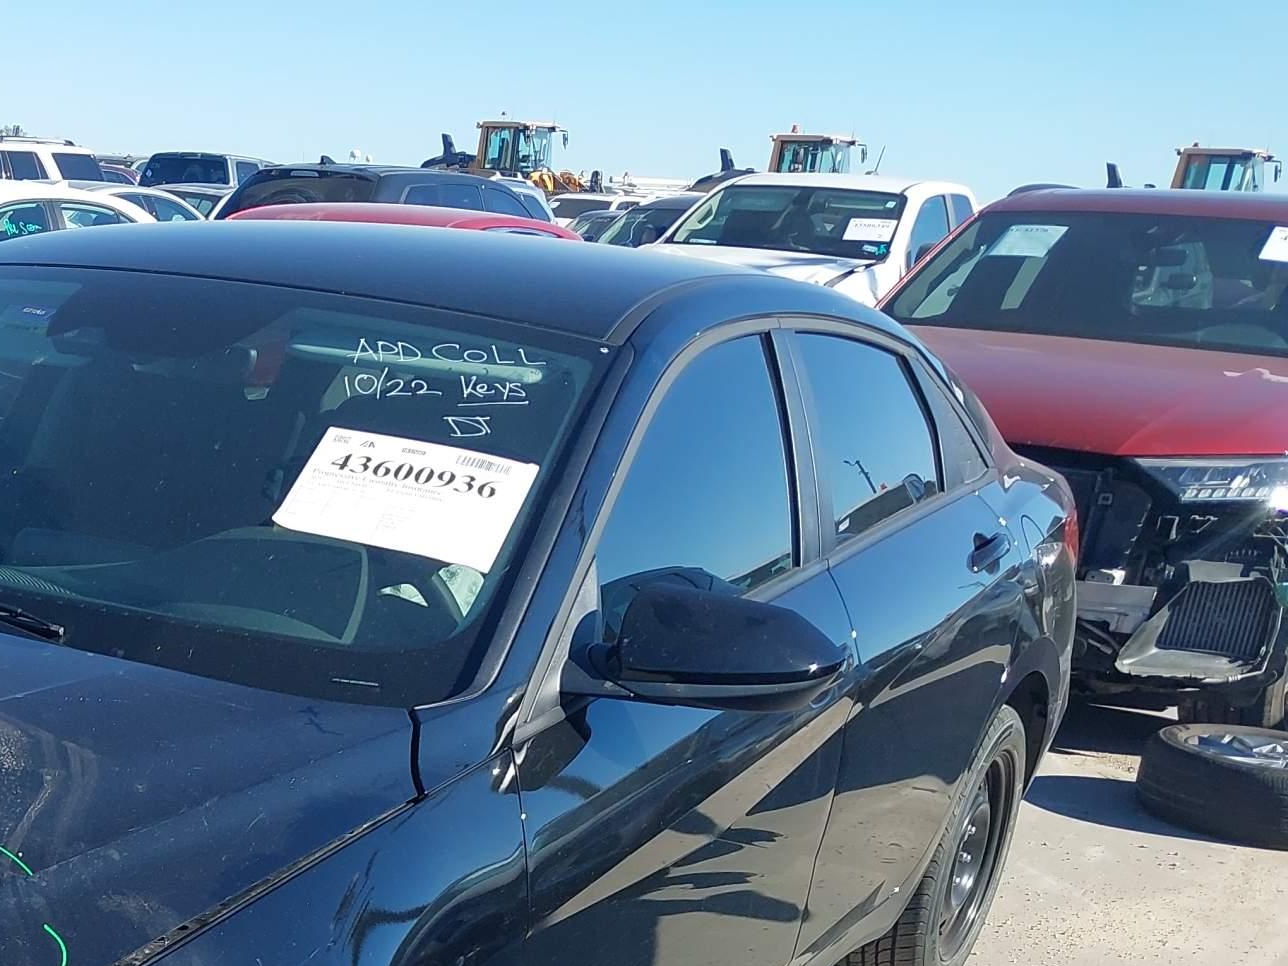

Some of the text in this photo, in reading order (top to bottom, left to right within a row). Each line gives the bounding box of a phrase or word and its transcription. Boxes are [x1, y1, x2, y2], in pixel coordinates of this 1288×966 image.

[346, 338, 422, 364] APD
[345, 367, 527, 401] 10/22 Keys
[330, 452, 504, 500] 43600936
